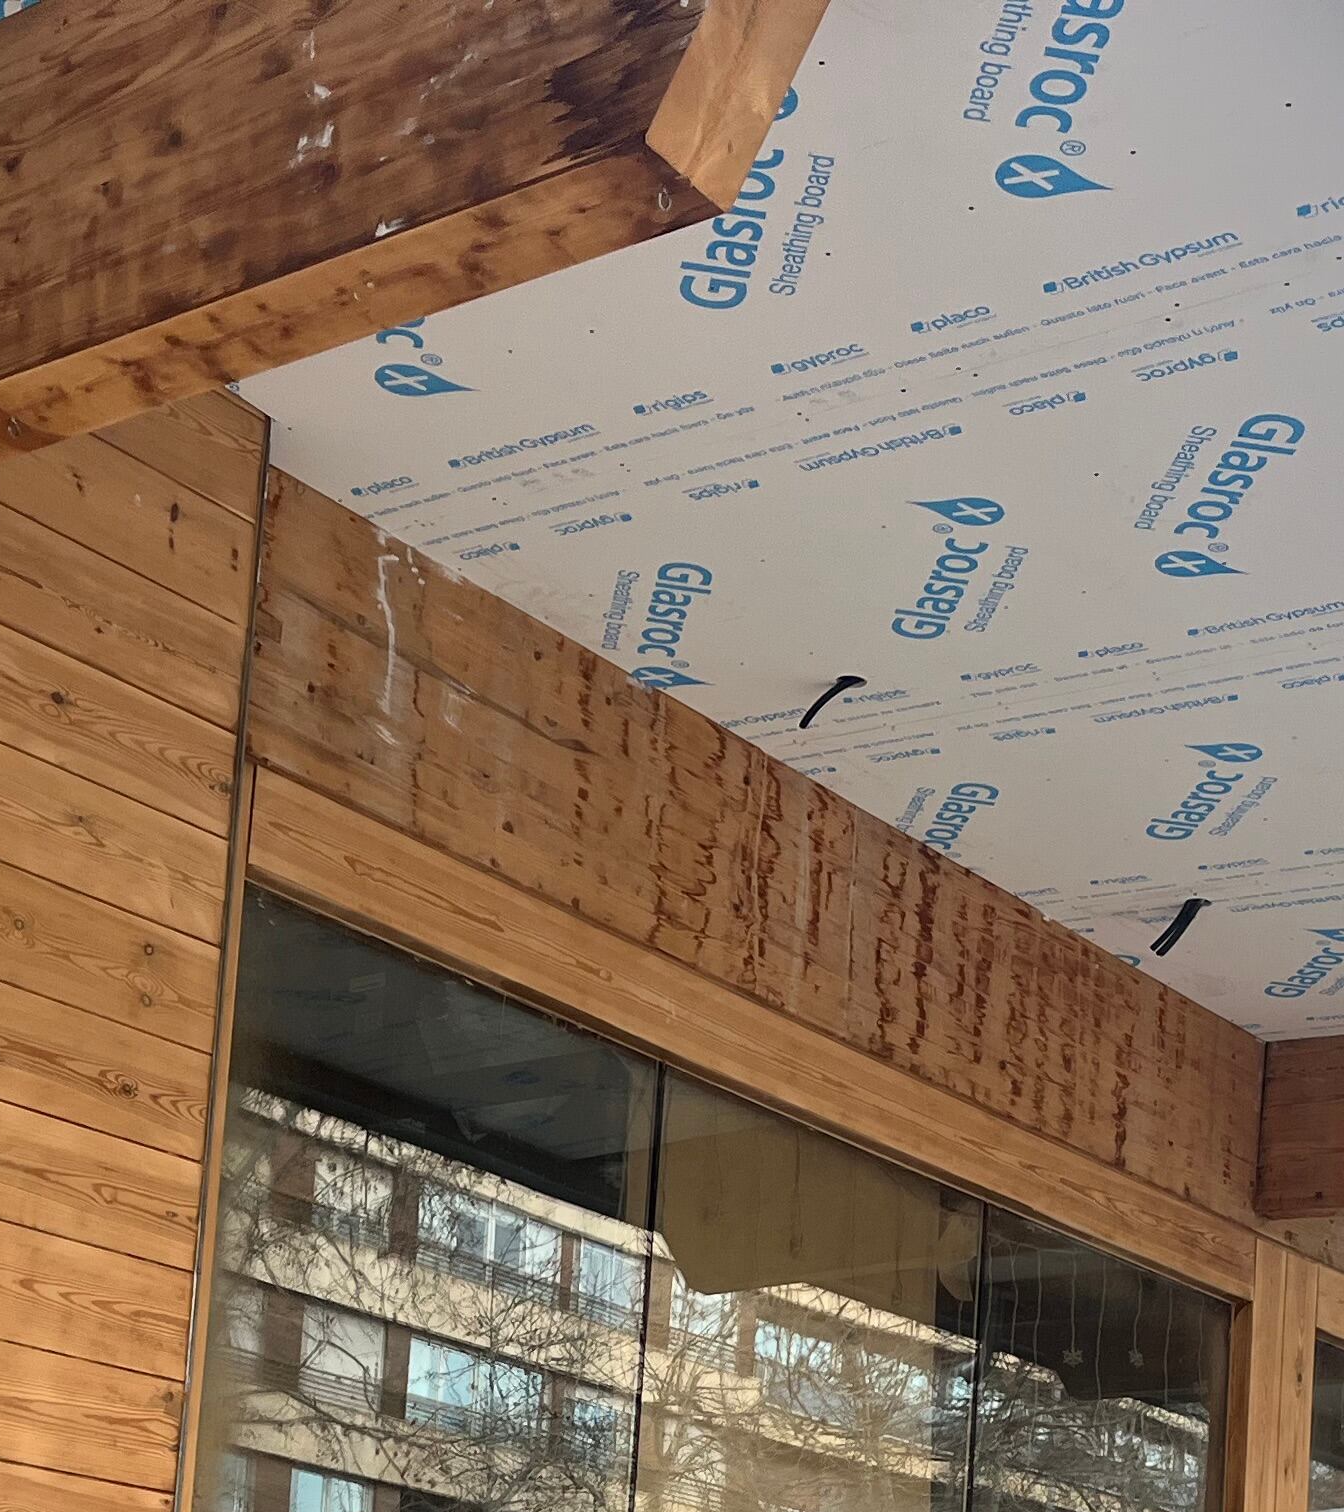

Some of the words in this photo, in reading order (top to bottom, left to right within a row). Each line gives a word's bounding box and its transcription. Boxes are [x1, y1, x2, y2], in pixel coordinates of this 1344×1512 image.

[980, 0, 1033, 57] thing
[963, 61, 1012, 123] board
[1015, 0, 1125, 134] asroc
[794, 152, 835, 209] board
[679, 149, 785, 310] Glasroc
[769, 208, 824, 296] Sheathing
[1063, 260, 1140, 291] British
[1138, 231, 1239, 264] Gypsum
[931, 306, 991, 331] placo
[791, 343, 864, 372] gyproc
[1135, 352, 1216, 382] gyproc
[652, 390, 709, 413] rigips
[1009, 393, 1066, 416] placo
[463, 442, 524, 467] British
[519, 422, 596, 451] Gypsum
[798, 446, 880, 472] Gypsum
[877, 429, 945, 452] British
[1151, 425, 1218, 492] Sheathing
[367, 475, 414, 496] placo
[1173, 413, 1306, 539] Glasroc
[554, 514, 616, 536] gyproc
[1134, 494, 1176, 531] board
[637, 562, 713, 658] Glasroc
[891, 537, 990, 640] Glasroc
[964, 581, 1015, 632] Sheathing
[992, 545, 1029, 580] board
[923, 782, 1000, 850] Glasroc
[1145, 770, 1244, 840] Glasroc
